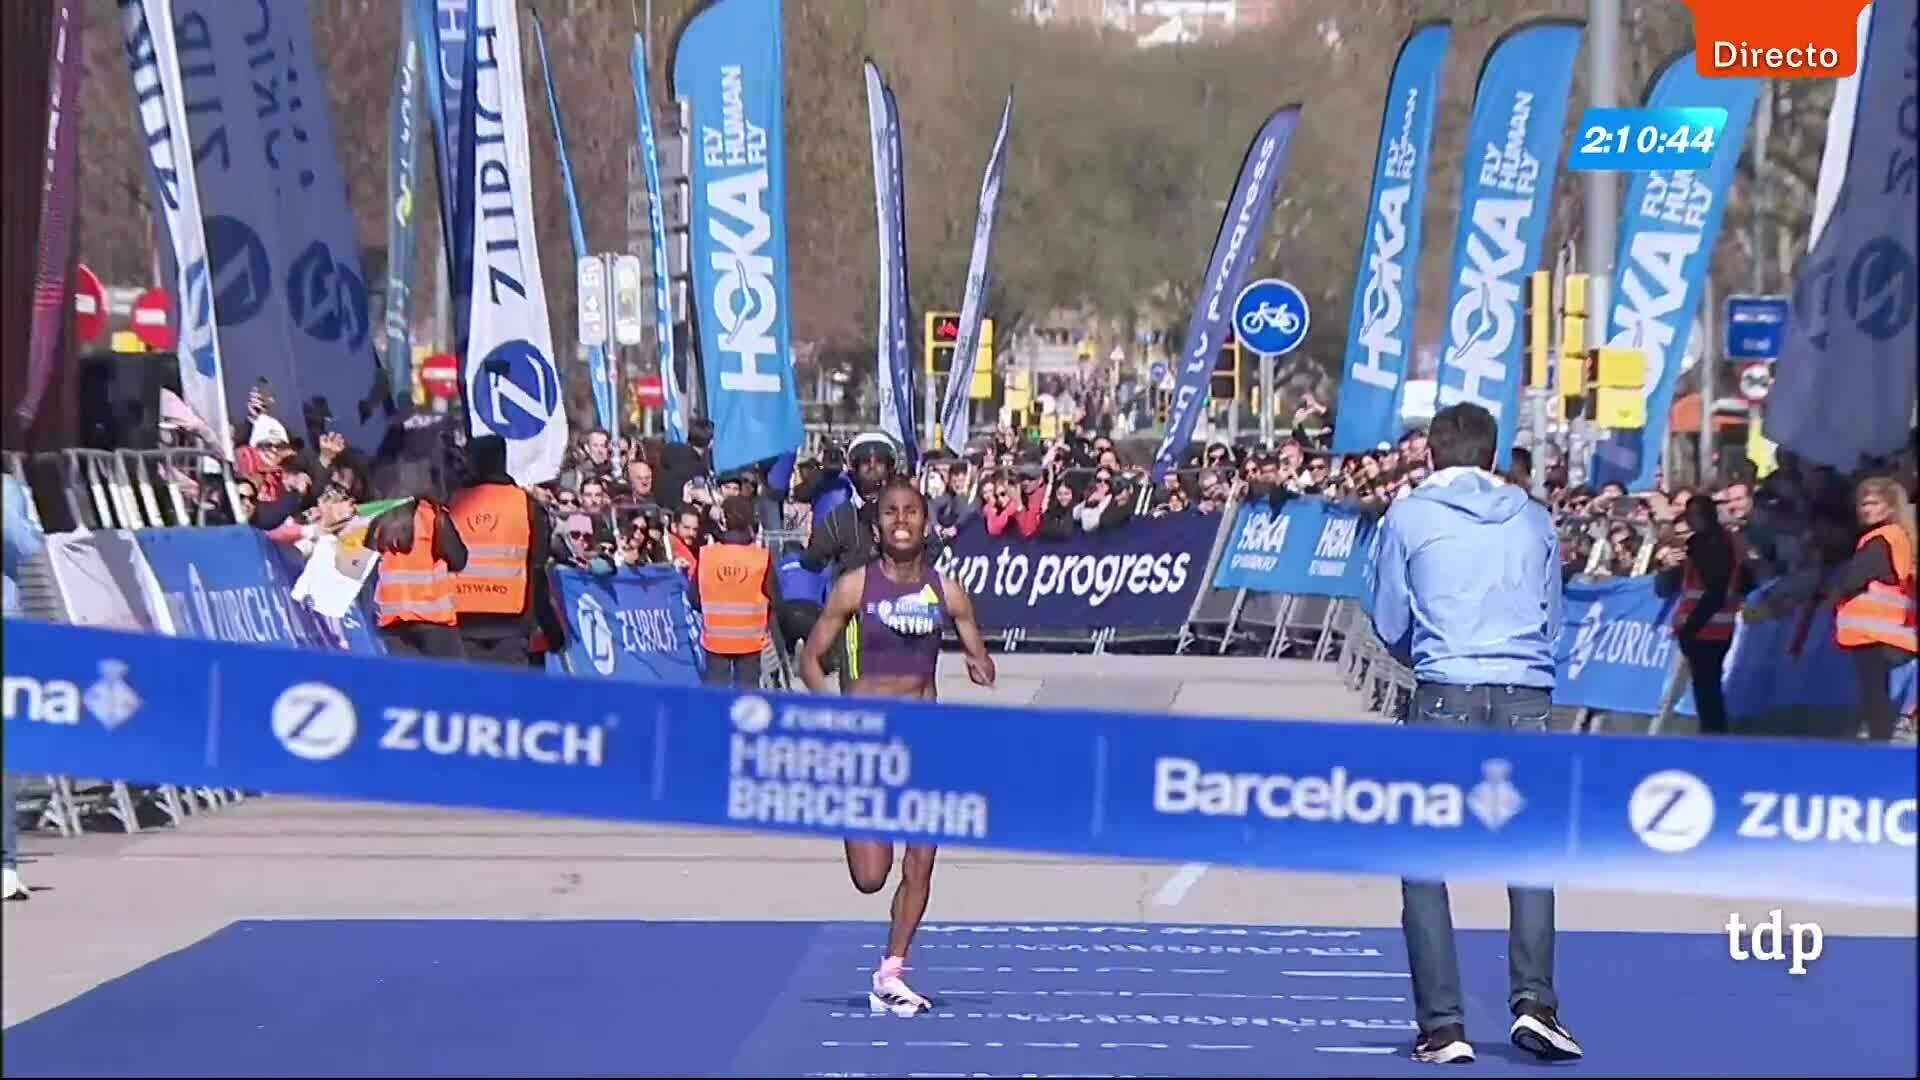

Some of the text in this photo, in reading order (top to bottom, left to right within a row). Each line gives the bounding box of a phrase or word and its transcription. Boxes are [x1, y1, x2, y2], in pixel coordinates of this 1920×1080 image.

[720, 64, 747, 166] HUMAN
[746, 119, 767, 165] FLY
[1497, 91, 1535, 191] HUMAN
[703, 125, 724, 167] FLY
[1479, 142, 1501, 186] FLY
[1515, 151, 1540, 194] FLY
[1684, 180, 1713, 228] FLY
[706, 168, 782, 393] HOKA
[1351, 184, 1411, 391] HOKA
[1438, 199, 1534, 419] HOKA
[455, 583, 509, 595] STEWARD
[995, 546, 1029, 596] to
[1027, 552, 1191, 607] progress
[615, 608, 678, 652] ZURICH
[1594, 618, 1672, 669] ZURICH
[379, 706, 604, 767] ZURICH
[780, 704, 887, 734] ZURICH
[727, 777, 988, 839] BARCELONA
[1154, 757, 1465, 828] Barcelona
